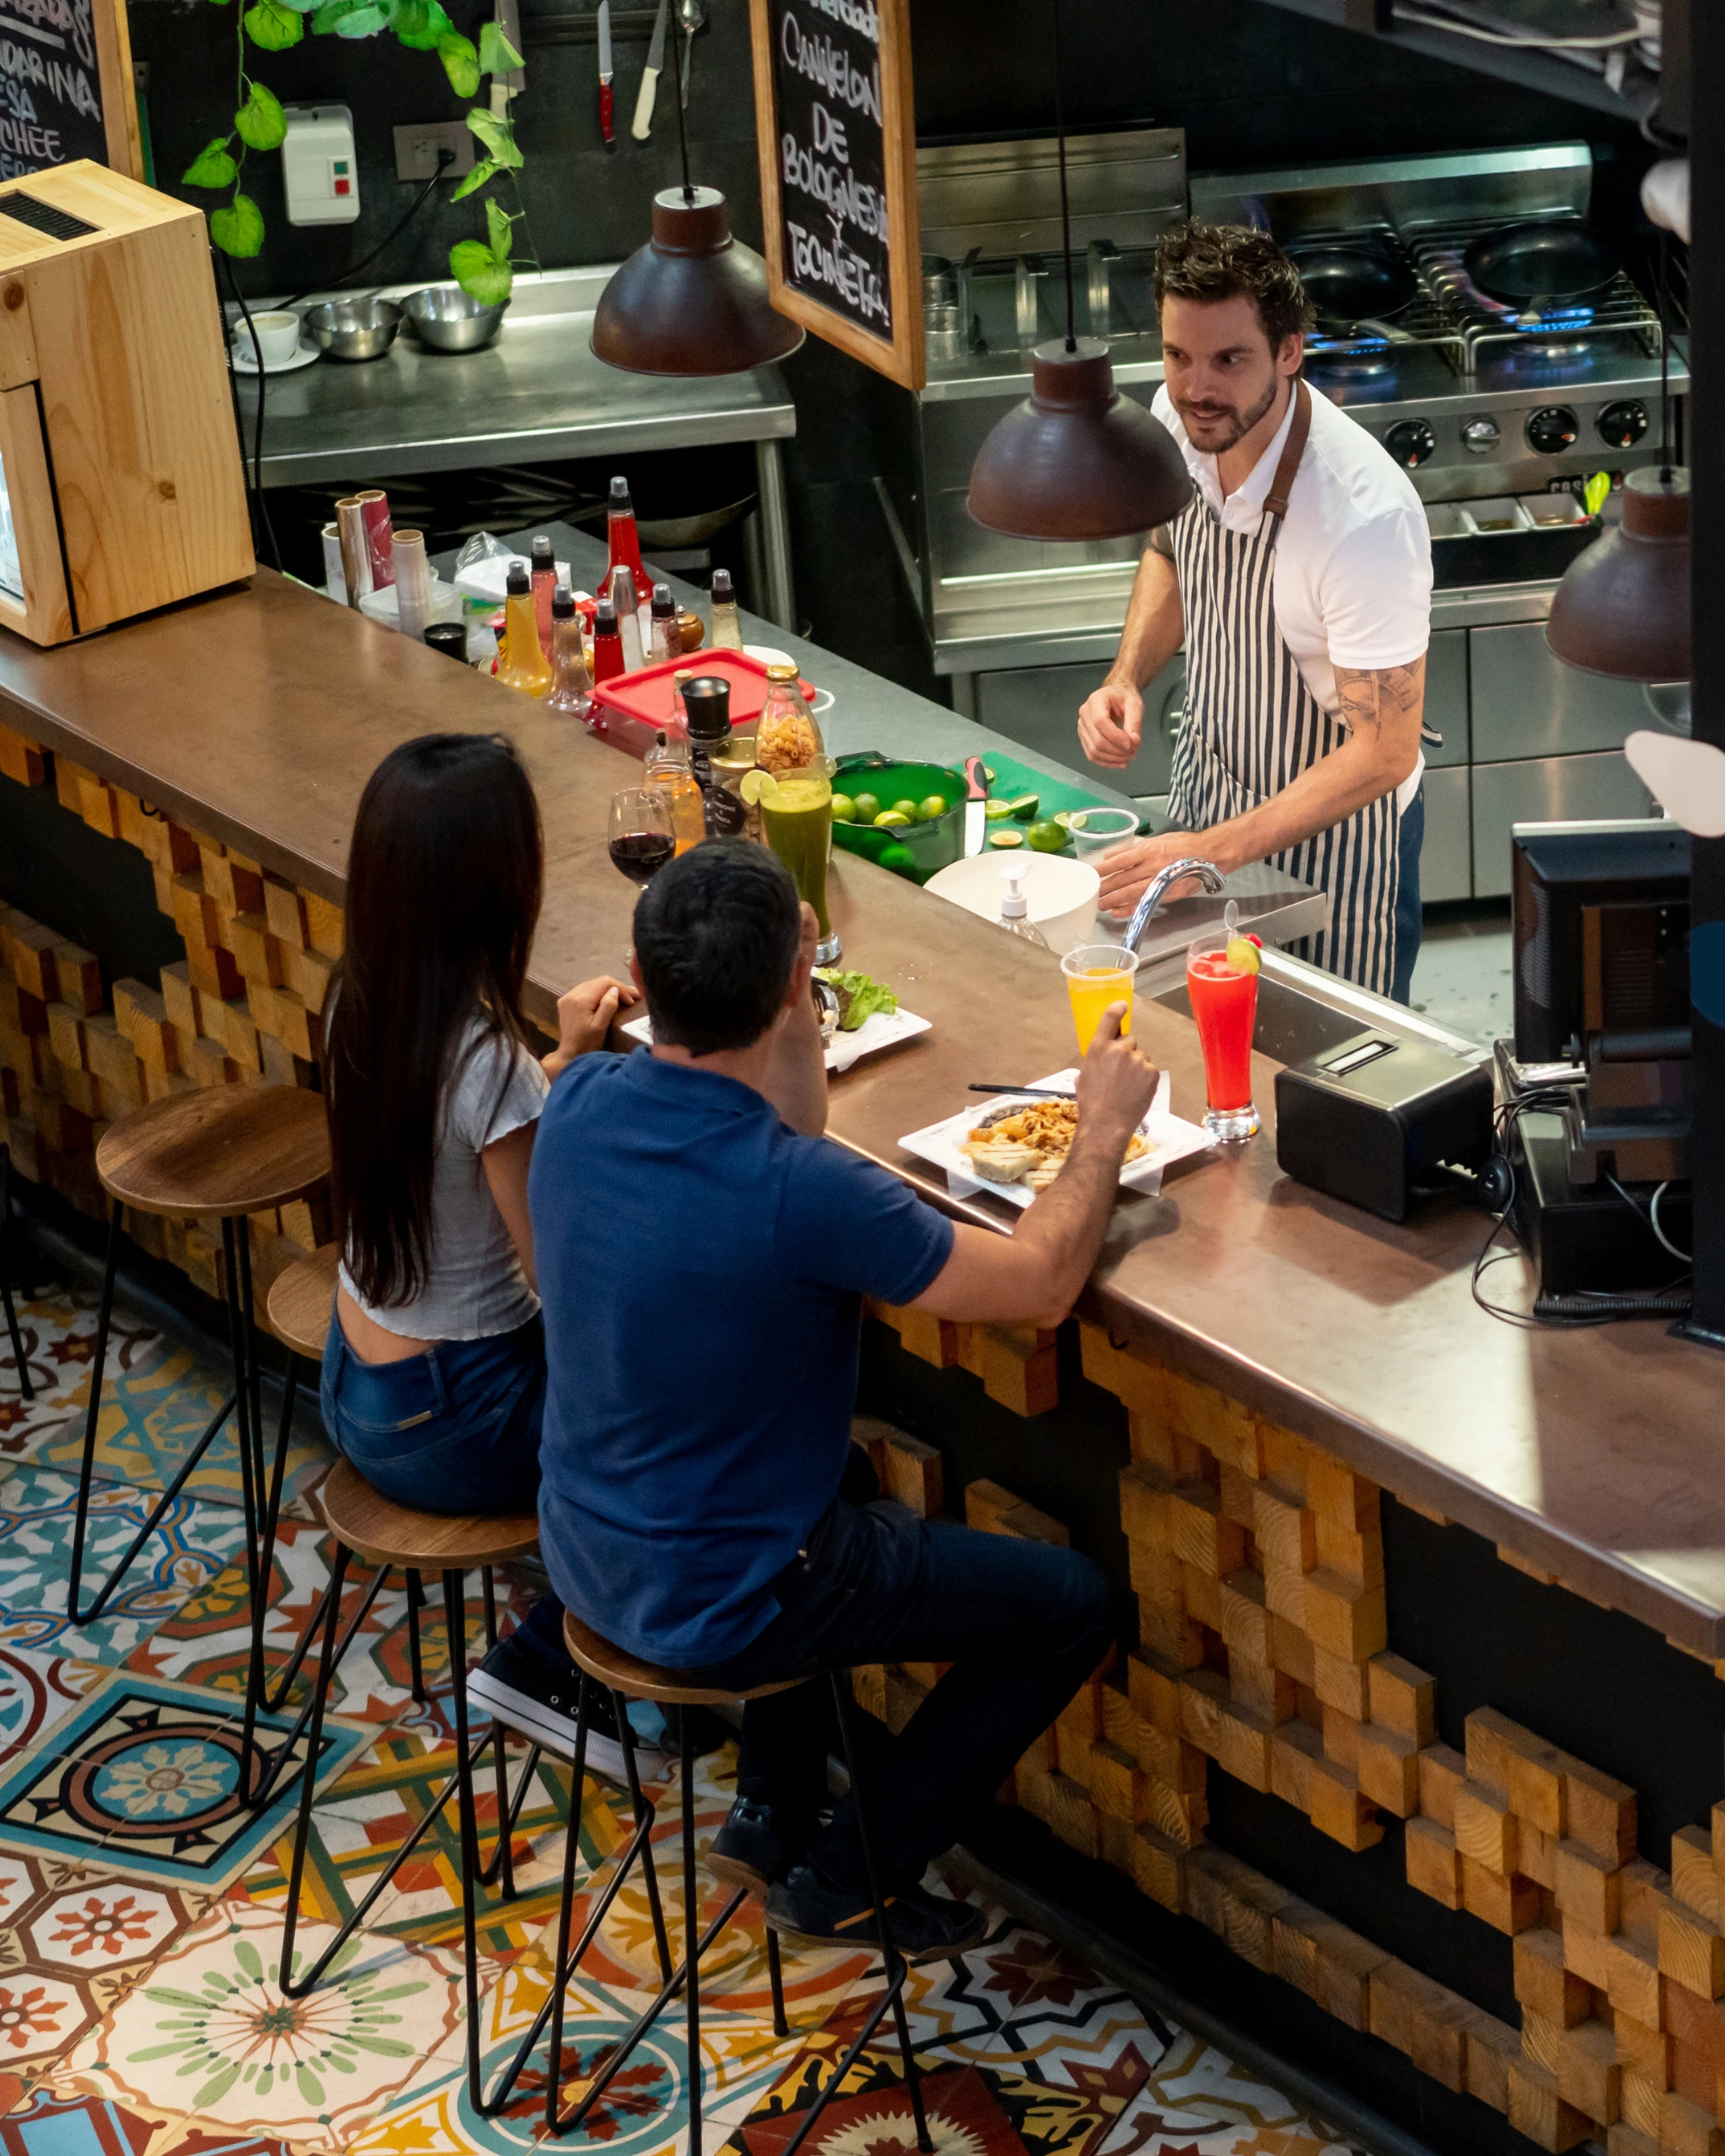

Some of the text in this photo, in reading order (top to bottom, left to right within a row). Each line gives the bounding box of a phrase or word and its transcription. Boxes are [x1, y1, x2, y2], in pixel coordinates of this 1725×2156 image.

[0, 38, 102, 122] DARINA
[0, 116, 66, 163] CHEE
[813, 101, 849, 164] DE
[826, 213, 844, 250] Y
